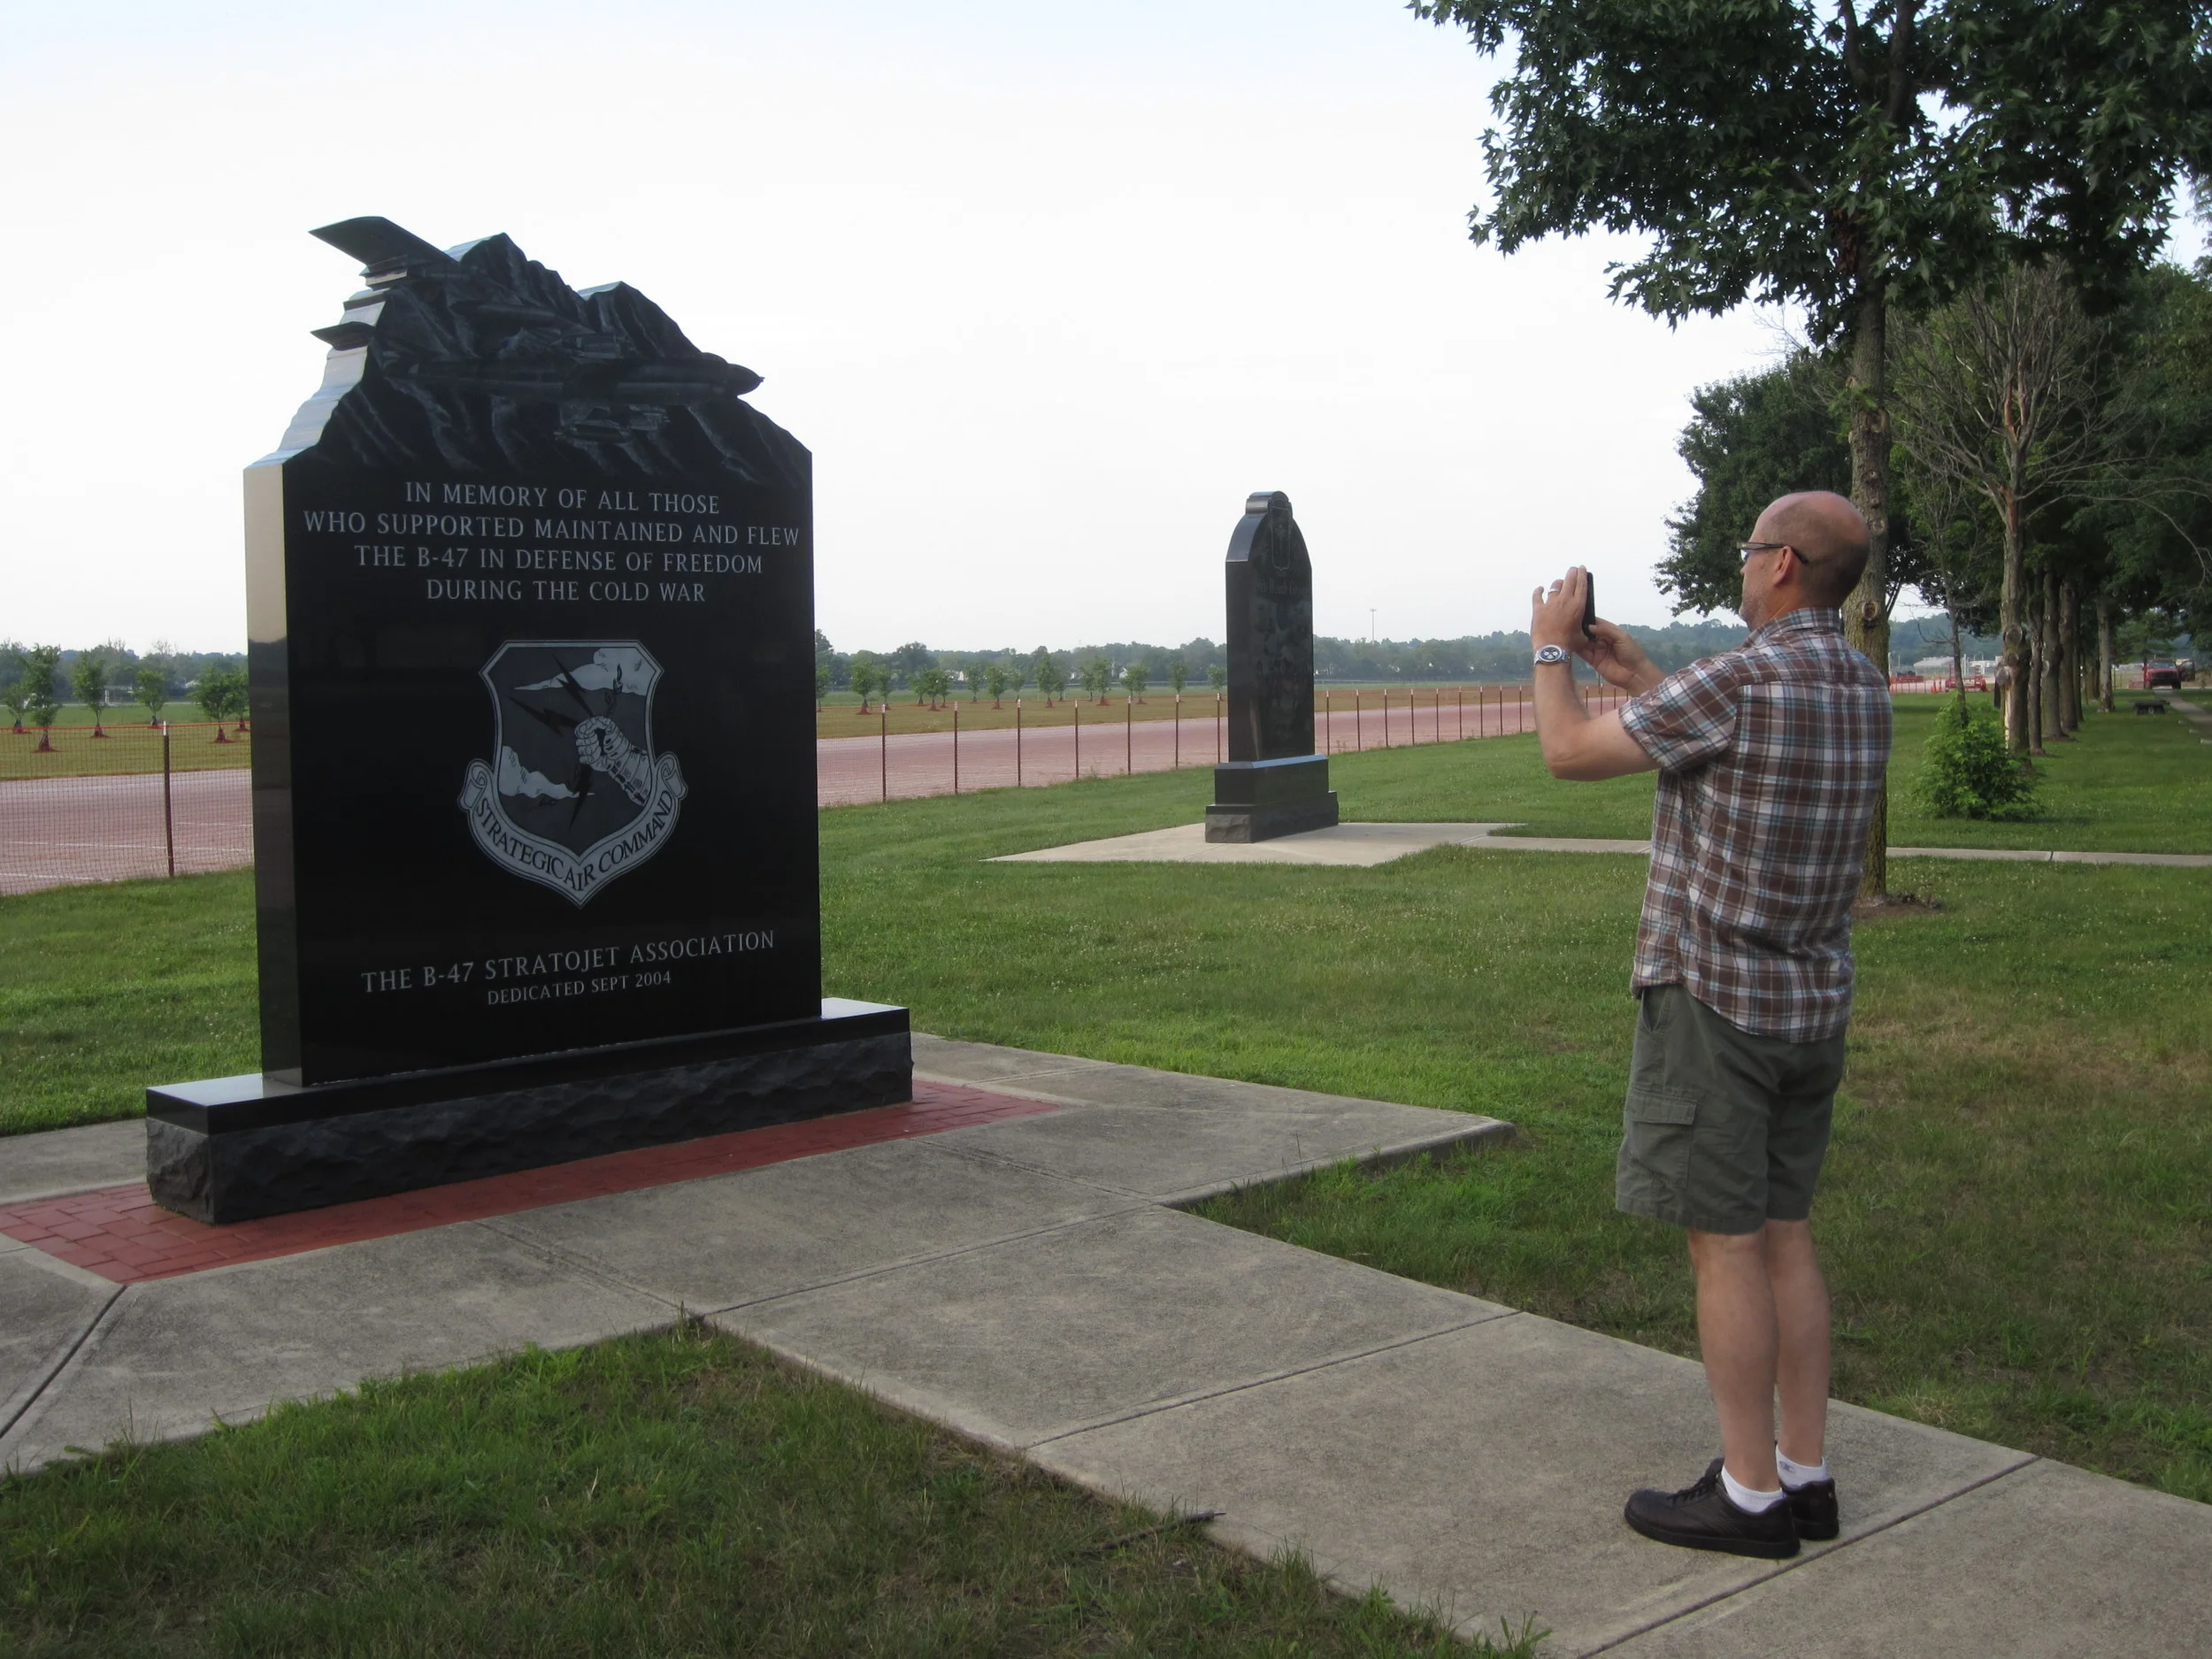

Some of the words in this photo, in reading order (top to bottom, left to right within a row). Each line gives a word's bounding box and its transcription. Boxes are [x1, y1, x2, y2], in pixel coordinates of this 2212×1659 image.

[407, 482, 430, 503] IN
[442, 484, 547, 506] MEMORY
[558, 489, 587, 508] OF
[598, 491, 639, 511] ALL
[649, 493, 719, 514] THOSE
[304, 511, 365, 533] WHO
[377, 514, 524, 538] SUPPORTED
[534, 519, 682, 542] MAINTAINED
[693, 526, 738, 544] AND
[748, 526, 799, 546] FLEW
[355, 545, 405, 566] THE
[418, 547, 468, 567] B-47
[480, 549, 503, 569] IN
[516, 549, 616, 571] DEFENSE
[626, 552, 654, 572] OF
[664, 554, 763, 573] FREEDOM
[426, 580, 522, 601] DURING
[533, 581, 580, 601] THE
[589, 582, 649, 602] COLD
[659, 583, 705, 602] WAR
[476, 798, 564, 877] STRATEGIC
[564, 864, 595, 891] AIR
[598, 789, 674, 873] COMMAND
[361, 969, 411, 993] THE
[424, 963, 474, 987] B-47
[485, 947, 619, 980] STRATOJET
[630, 930, 774, 964] ASSOCIATION
[488, 980, 585, 1005] DEDICATED
[591, 975, 629, 993] SEPT
[635, 971, 672, 988] 2004
